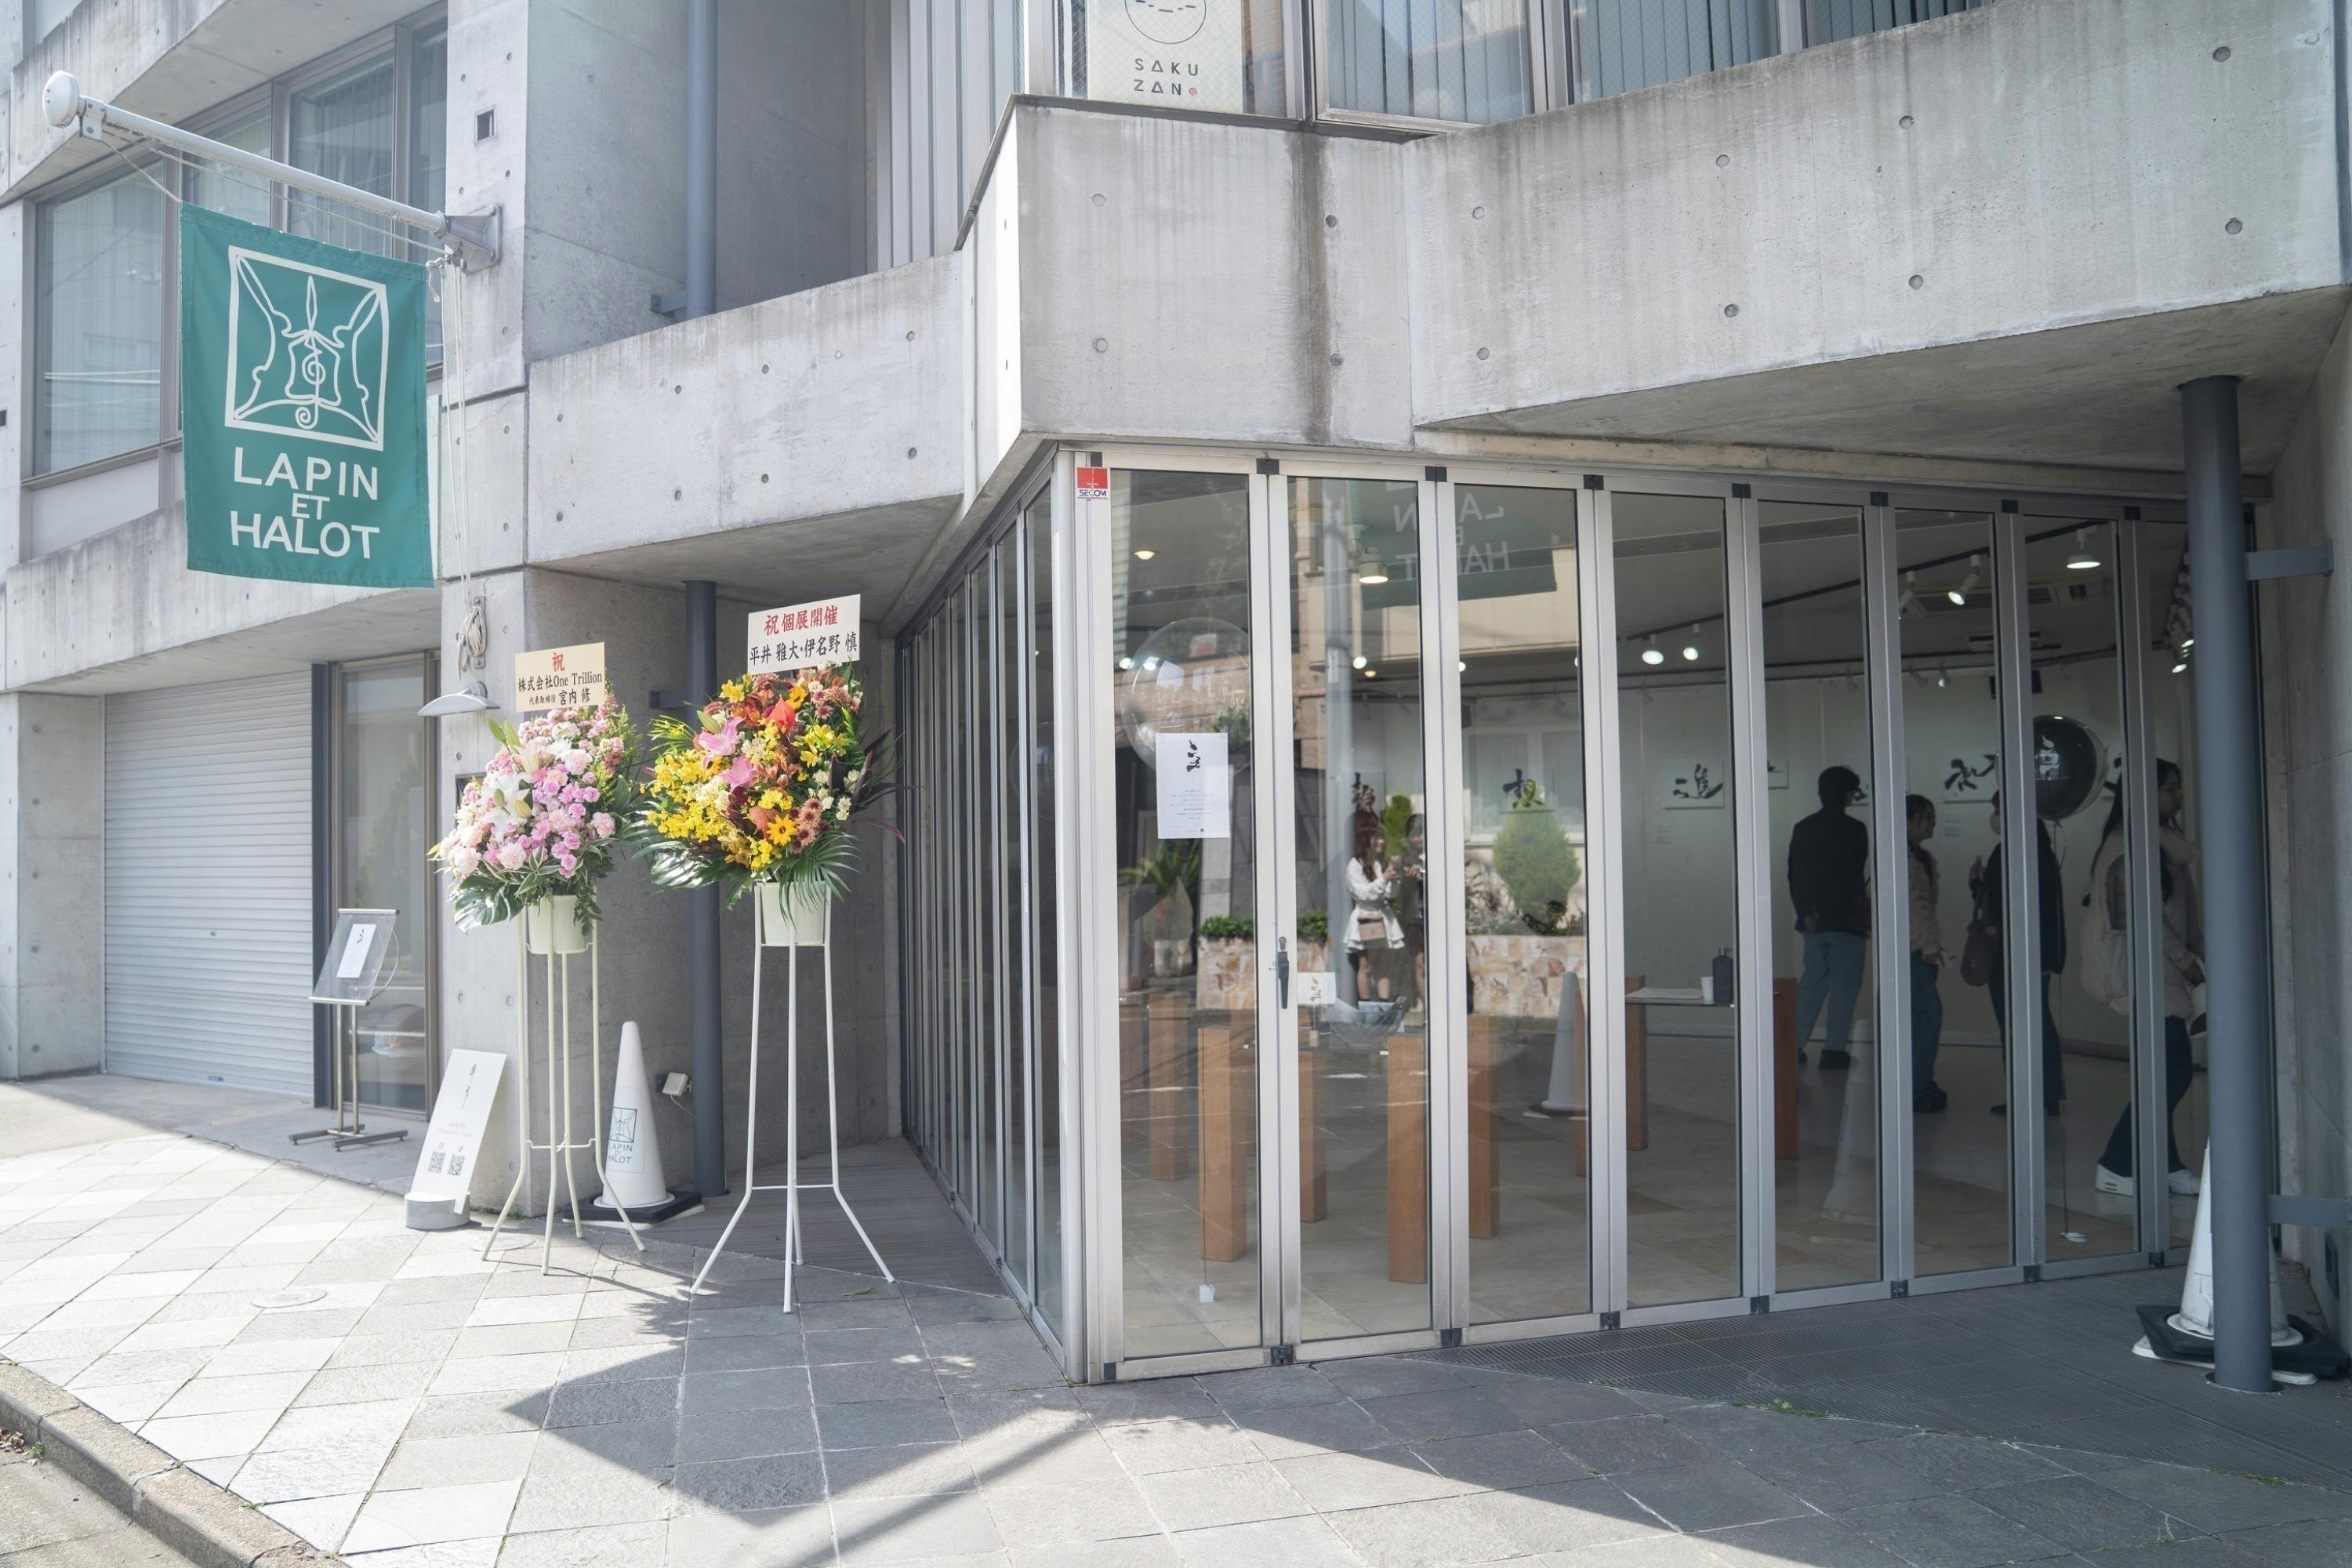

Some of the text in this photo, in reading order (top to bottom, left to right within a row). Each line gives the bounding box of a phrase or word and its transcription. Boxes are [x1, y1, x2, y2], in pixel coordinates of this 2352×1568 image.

[1134, 58, 1199, 76] SAKU
[234, 446, 378, 500] LAPIN
[292, 492, 330, 521] ET
[230, 510, 380, 559] HALOT
[551, 652, 565, 672] 祝
[572, 671, 602, 685] Trillion
